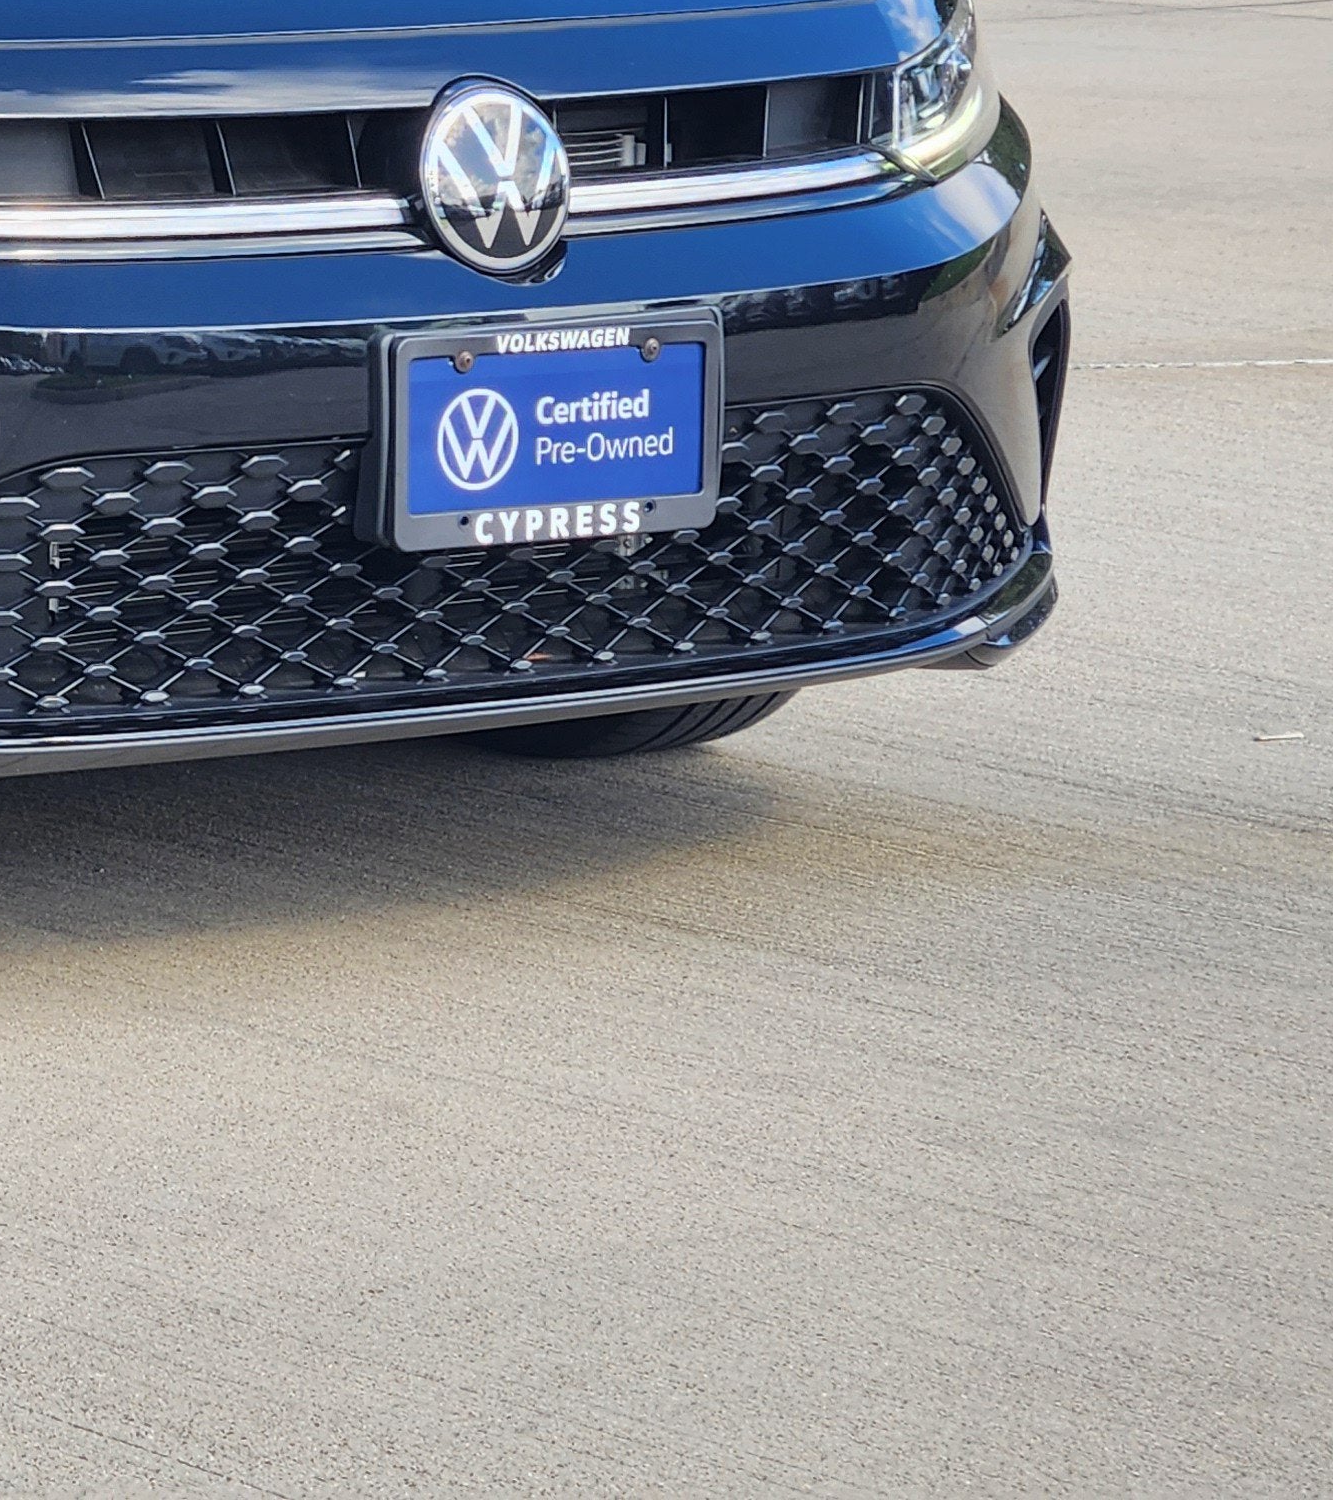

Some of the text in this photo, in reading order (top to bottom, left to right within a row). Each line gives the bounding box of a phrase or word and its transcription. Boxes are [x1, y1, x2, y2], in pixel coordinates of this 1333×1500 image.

[496, 327, 631, 354] VOLKSWAGEN
[536, 389, 650, 425] Certified
[536, 426, 674, 466] Pre-Owned
[474, 502, 641, 544] CYPRESS
